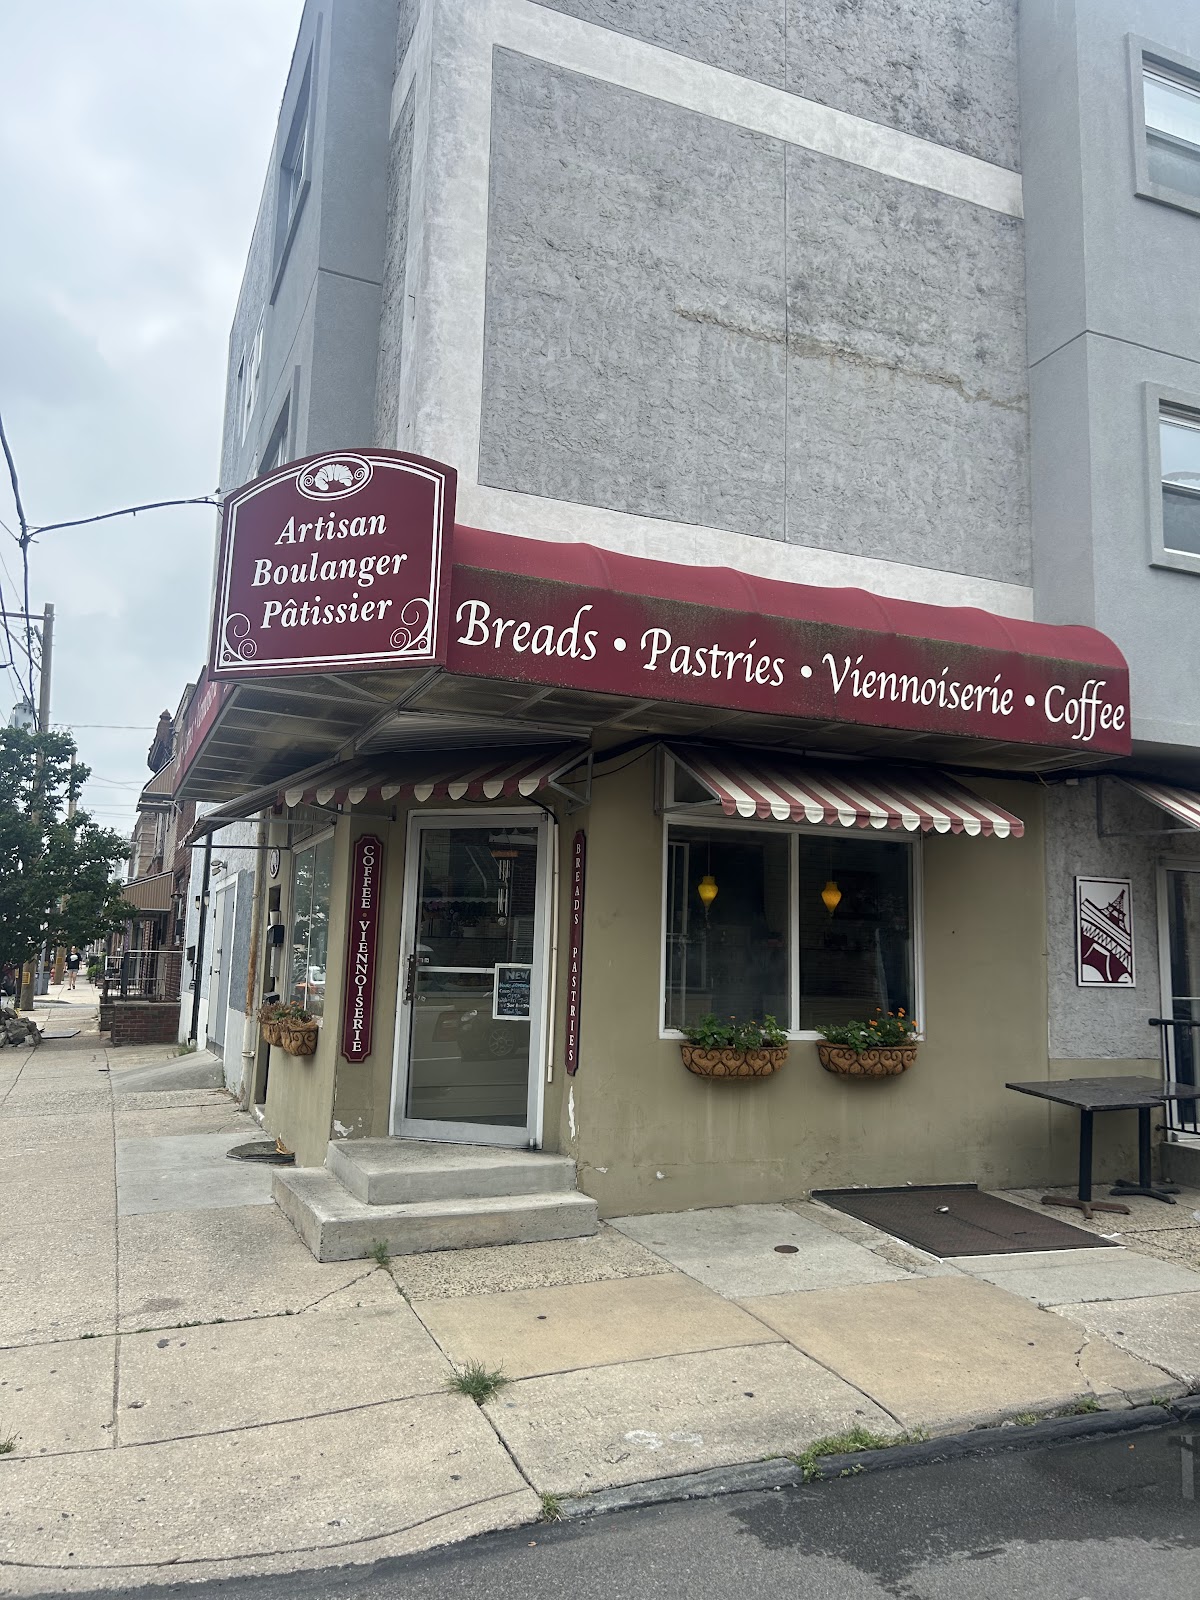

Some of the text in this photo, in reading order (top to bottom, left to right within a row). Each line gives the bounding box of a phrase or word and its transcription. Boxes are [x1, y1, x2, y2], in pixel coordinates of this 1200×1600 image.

[274, 511, 387, 546] Artisan
[251, 552, 408, 588] Boulanger
[260, 592, 393, 629] Pâtissier
[455, 599, 1126, 742] Breads Pastries Viennoiserie Coffee
[351, 845, 375, 1052] COFFEE VIENNOISERIE
[568, 843, 582, 1062] BREADS PASTRIES
[505, 970, 529, 980] NEW
